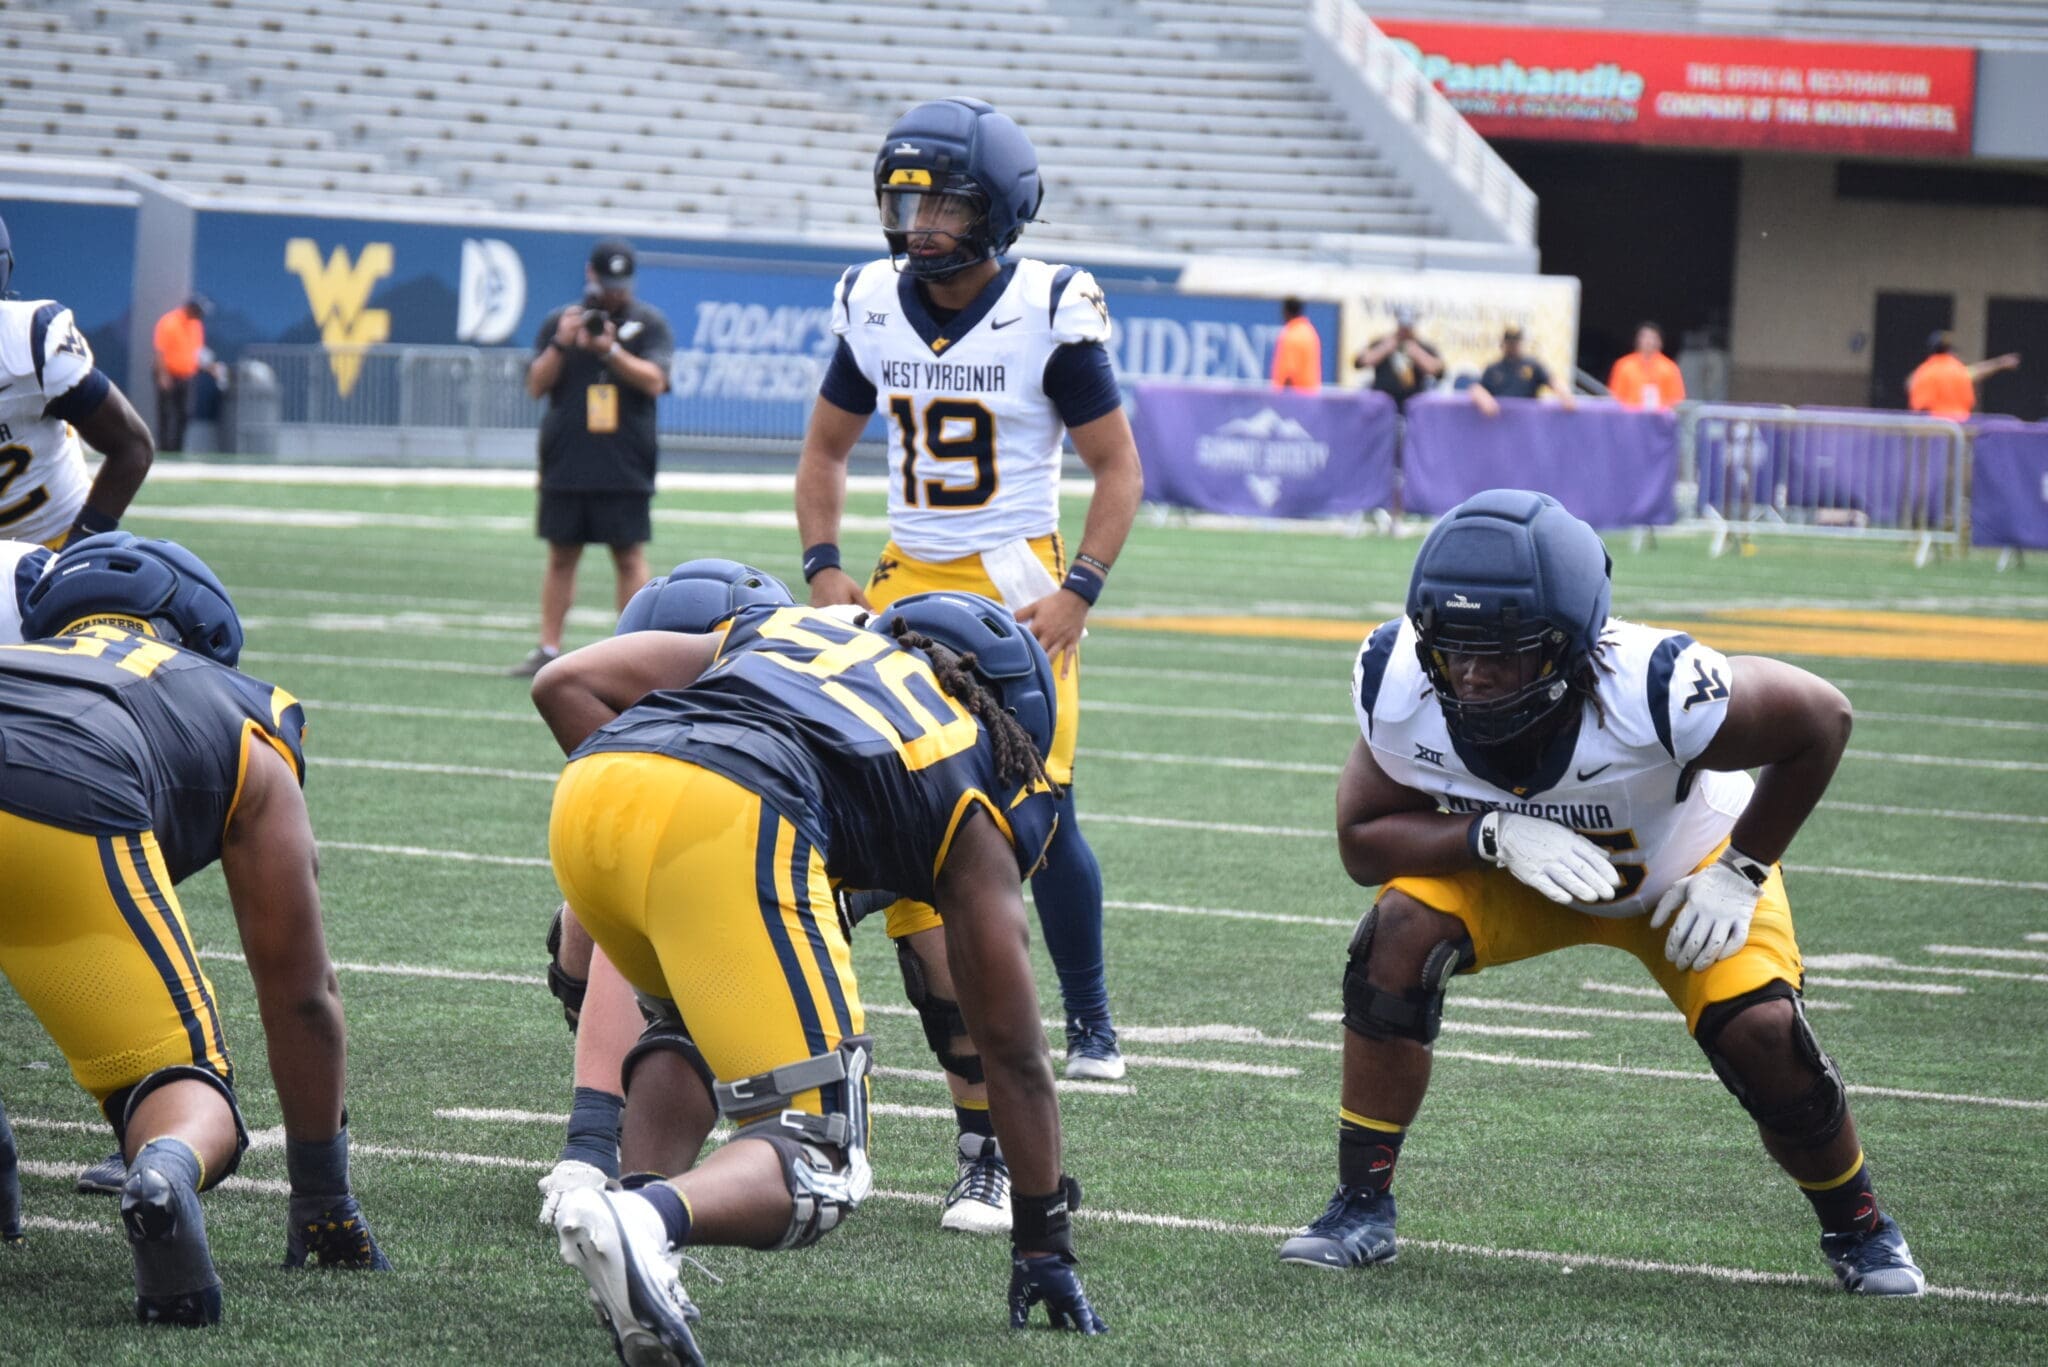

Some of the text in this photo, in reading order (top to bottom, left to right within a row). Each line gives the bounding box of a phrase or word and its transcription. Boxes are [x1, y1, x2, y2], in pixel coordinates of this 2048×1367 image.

[881, 360, 1005, 392] WEST VIRGINIA
[889, 394, 999, 510] 19
[1414, 742, 1445, 768] XII
